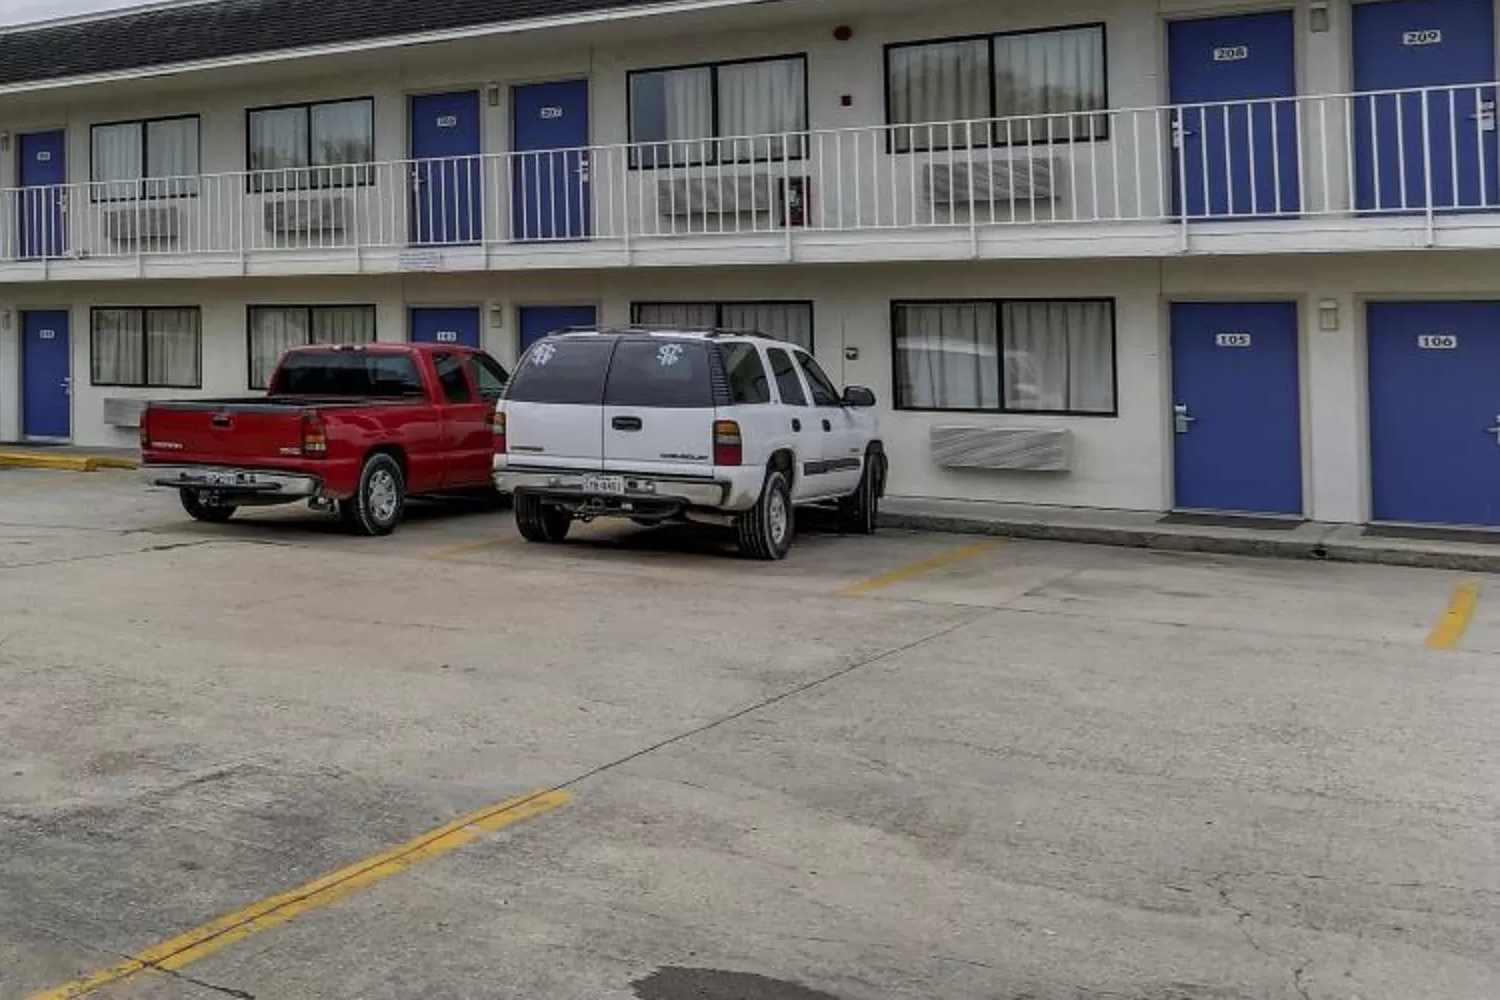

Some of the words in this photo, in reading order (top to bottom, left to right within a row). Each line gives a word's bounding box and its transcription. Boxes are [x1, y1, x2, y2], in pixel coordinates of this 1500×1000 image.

[1406, 30, 1439, 44] 209
[1219, 335, 1248, 346] 105
[1421, 336, 1454, 347] 106
